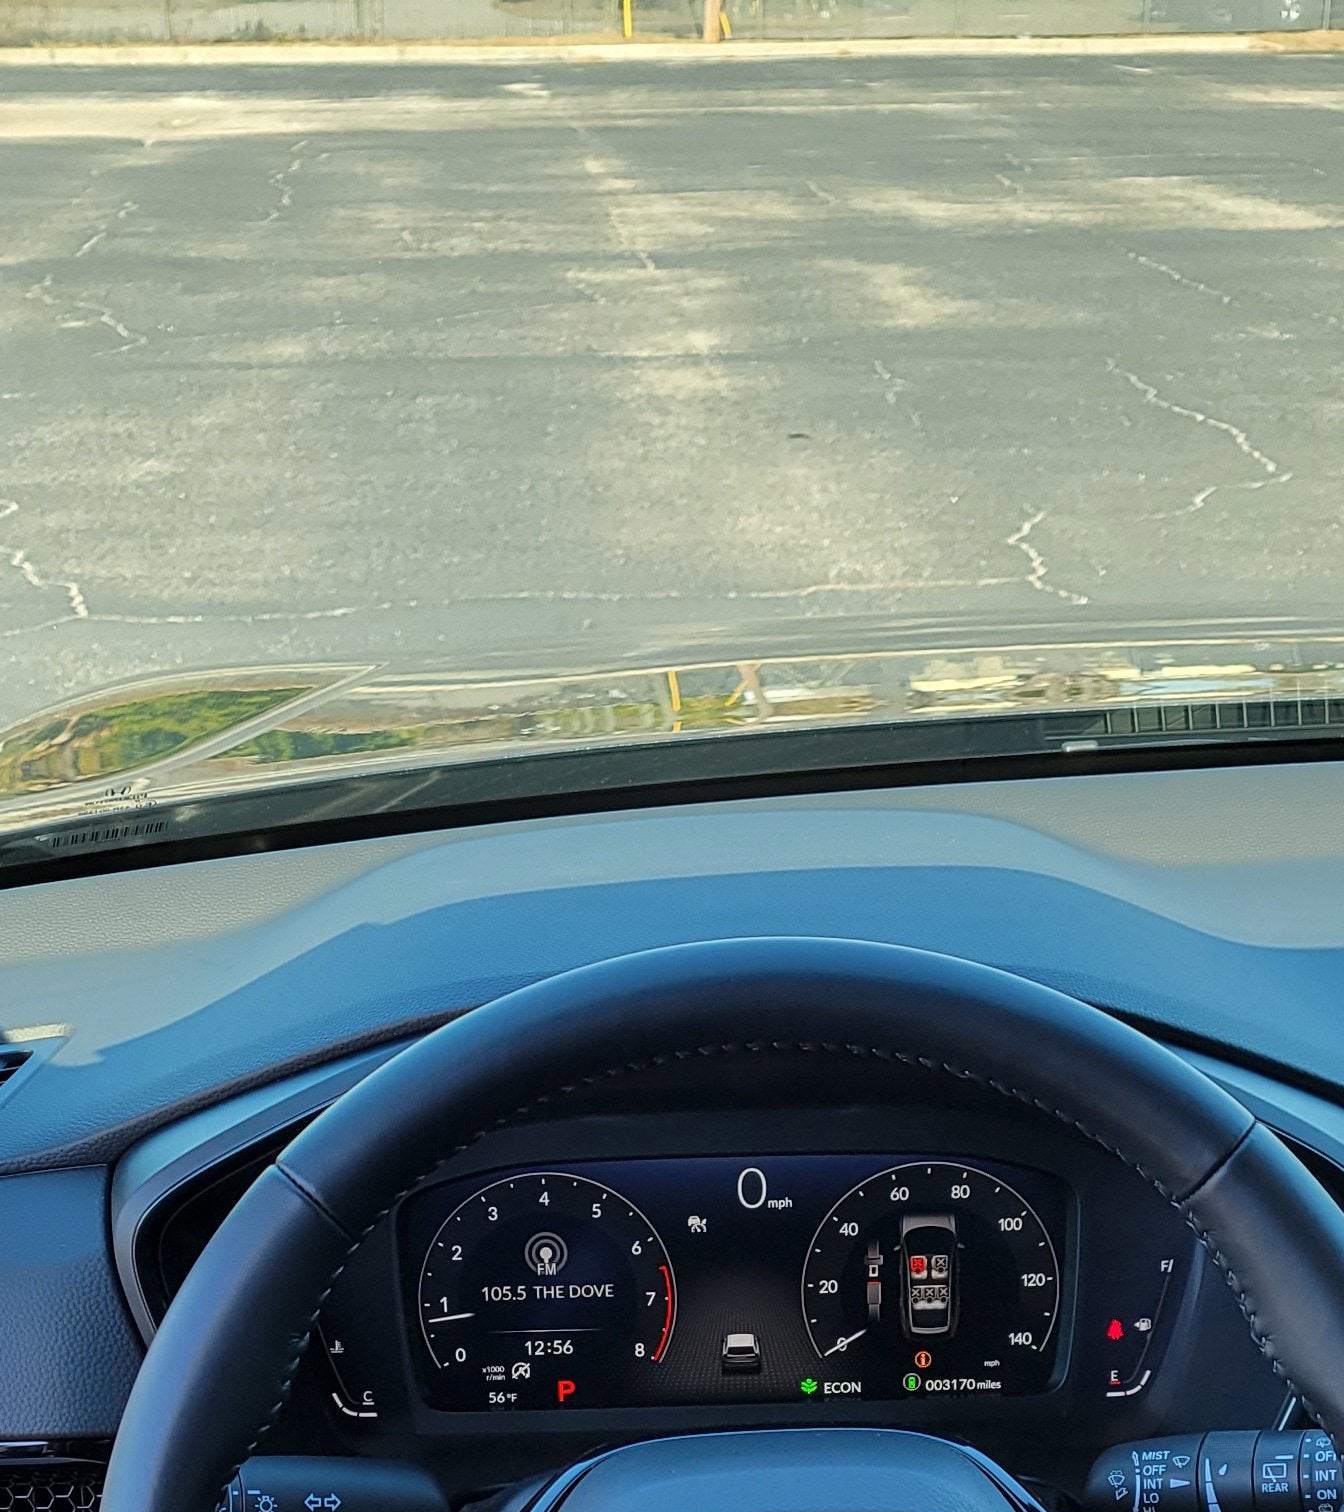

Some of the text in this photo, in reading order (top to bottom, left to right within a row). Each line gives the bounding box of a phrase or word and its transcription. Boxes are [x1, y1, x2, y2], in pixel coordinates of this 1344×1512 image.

[737, 1167, 793, 1210] 0 mph
[890, 1186, 910, 1201] 60
[951, 1184, 971, 1200] 80
[539, 1192, 550, 1206] 4
[488, 1207, 498, 1221] 3
[591, 1204, 602, 1218] 5
[839, 1222, 859, 1237] 40
[998, 1217, 1023, 1232] 100
[451, 1246, 463, 1260] 2
[631, 1241, 642, 1256] 6
[537, 1263, 557, 1276] FM
[818, 1279, 839, 1294] 20
[1021, 1273, 1046, 1287] 120
[481, 1284, 614, 1301] 105.5 THE DOVE
[645, 1292, 656, 1306] 7
[440, 1297, 448, 1313] 1
[1008, 1332, 1033, 1347] 140
[455, 1348, 467, 1362] 0
[524, 1340, 574, 1356] 12:56
[634, 1343, 645, 1357] 8
[984, 1359, 1001, 1369] mph
[486, 1373, 506, 1382] r/min
[1110, 1370, 1119, 1383] E
[557, 1380, 576, 1402] P
[823, 1381, 862, 1395] ECON
[925, 1378, 1002, 1392] 003170 miles
[363, 1390, 373, 1402] C
[1141, 1450, 1170, 1461] MIST
[1142, 1465, 1167, 1476] OFF
[1314, 1469, 1338, 1482] INT
[1143, 1478, 1164, 1490] INT
[1261, 1482, 1289, 1494] REAR
[1143, 1492, 1160, 1504] LO
[1316, 1488, 1338, 1501] ON
